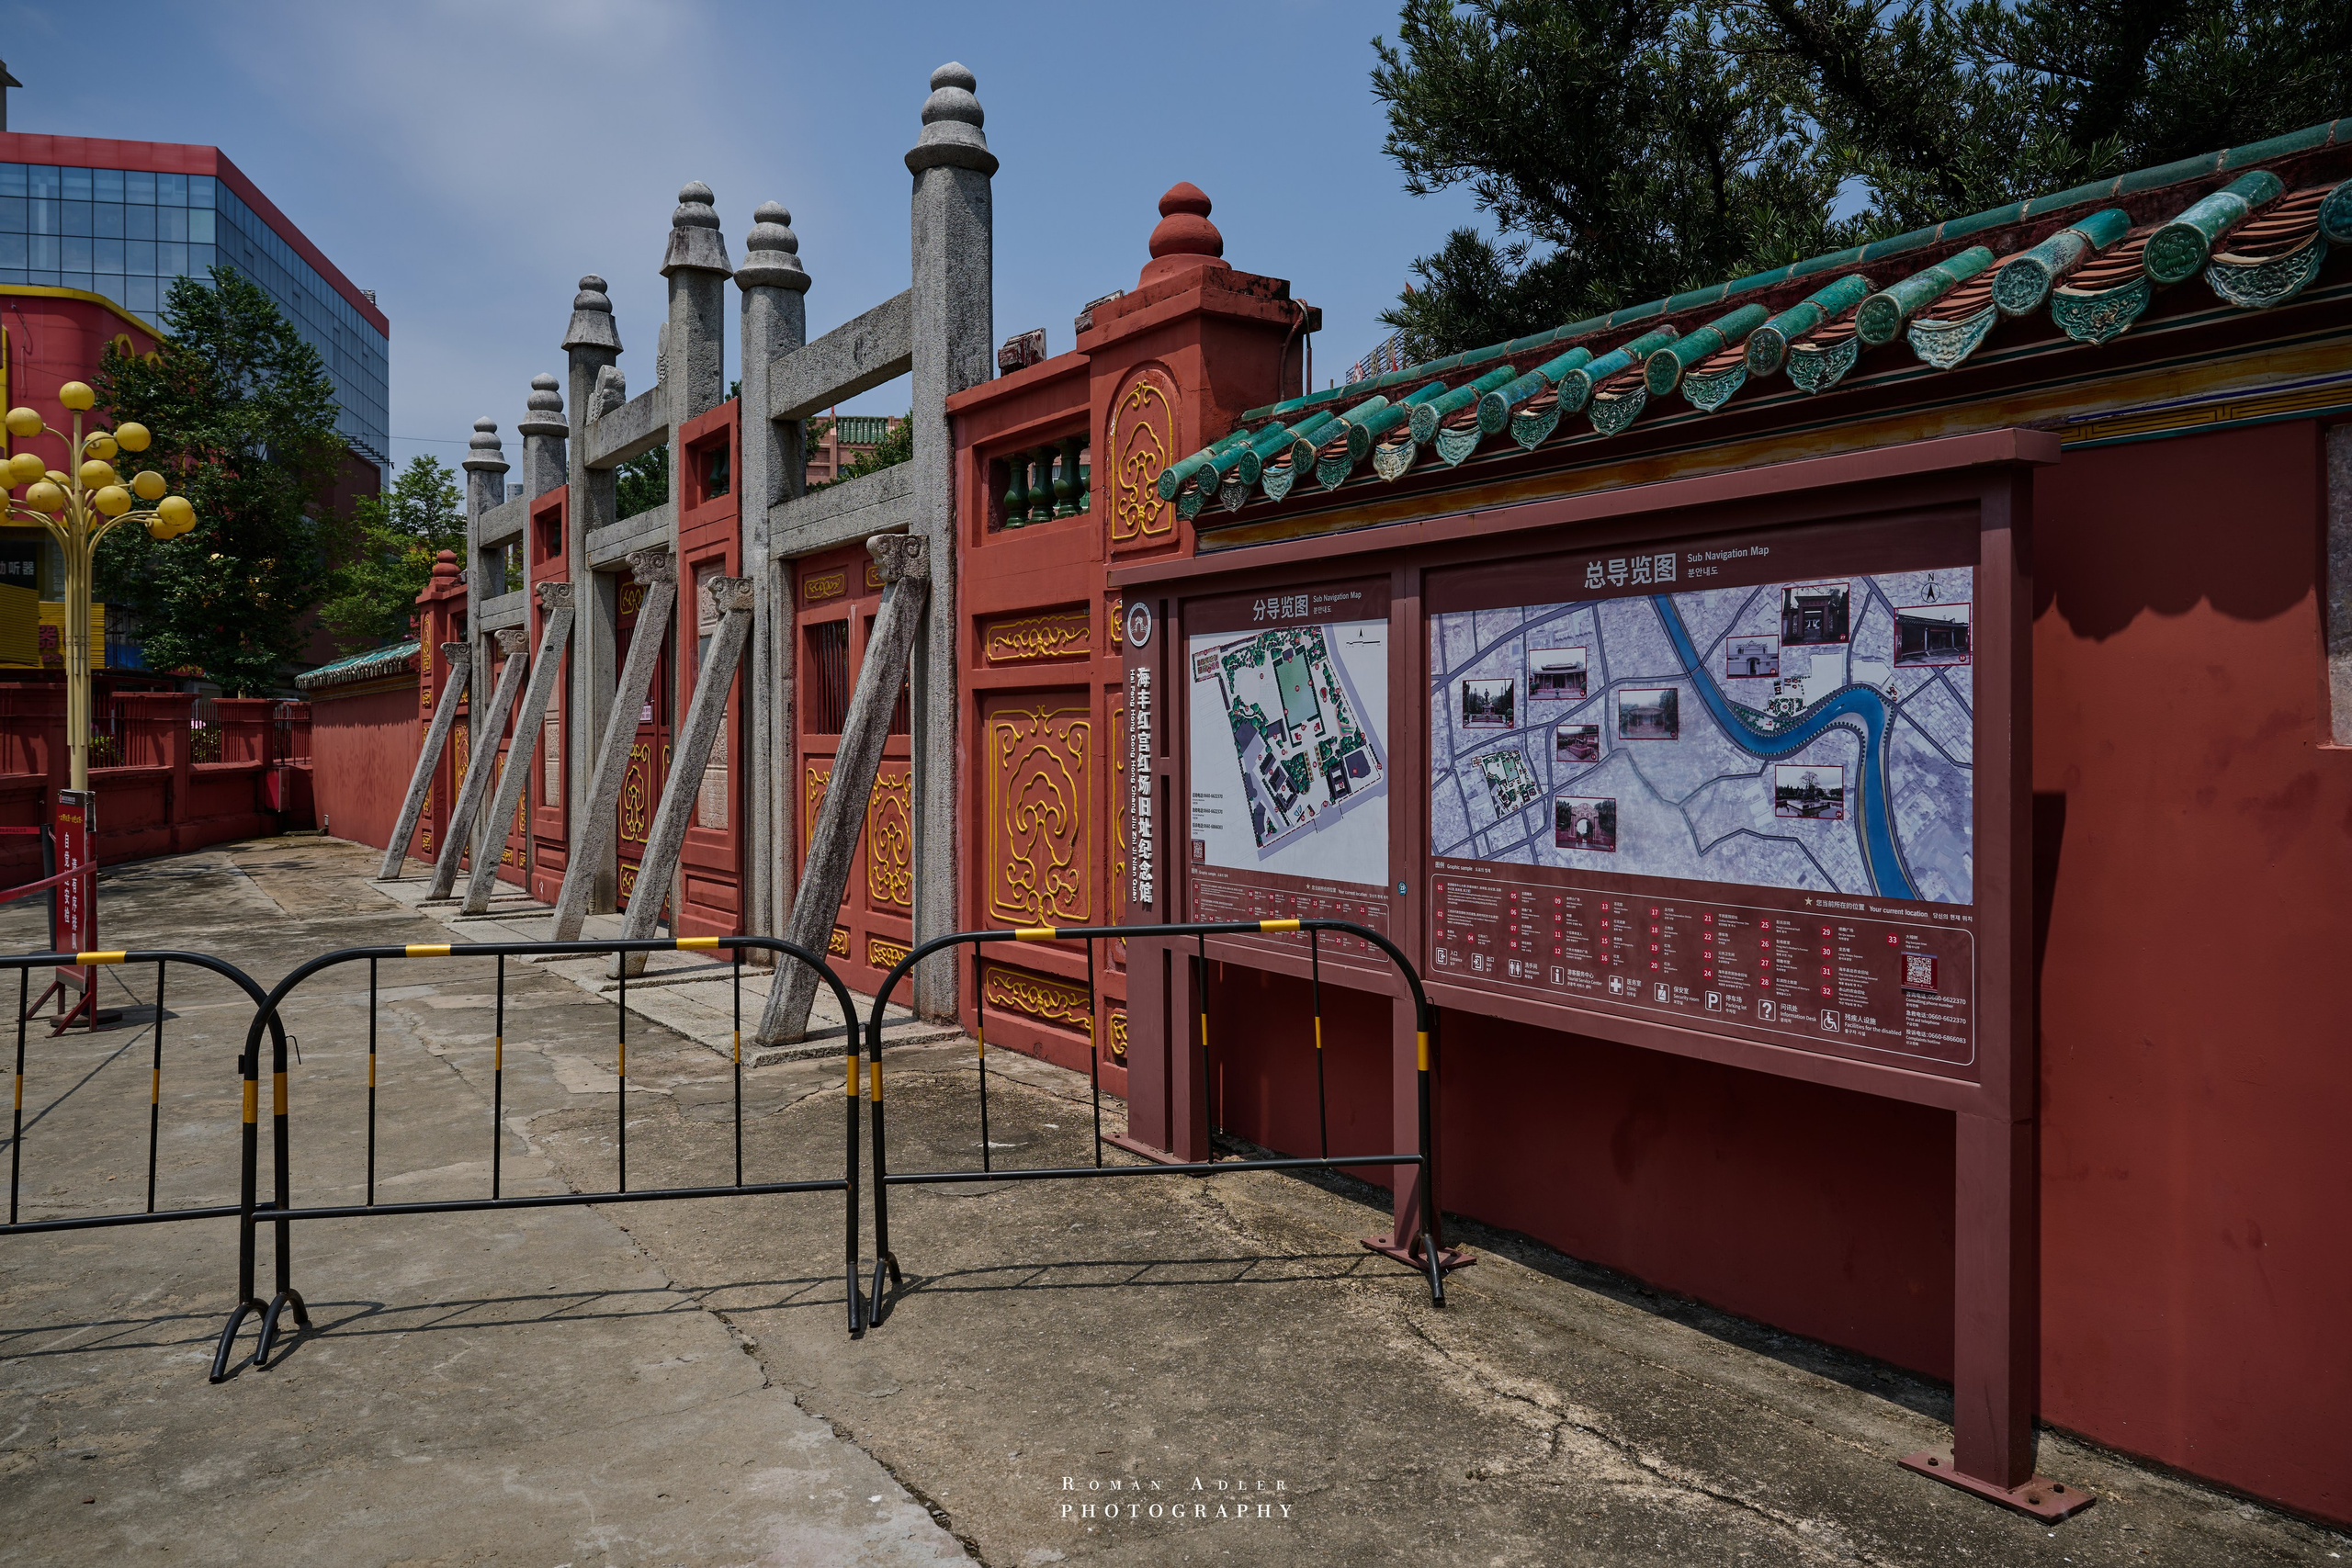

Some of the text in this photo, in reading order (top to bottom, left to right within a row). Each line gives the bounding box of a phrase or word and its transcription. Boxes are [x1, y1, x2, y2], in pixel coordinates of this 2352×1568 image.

[1687, 546, 1770, 563] Sub Navigation Map
[1584, 553, 1677, 589] 总导览图
[1687, 566, 1718, 578] 분안내도
[1324, 592, 1349, 602] Navigation
[1351, 591, 1362, 599] Map
[1253, 594, 1308, 621] 分导览图
[1136, 667, 1152, 903] 海丰红宫红场旧址纪念馆
[1816, 899, 1865, 910] 您当前所在的位置
[1883, 907, 1904, 915] current
[1905, 908, 1928, 917] location
[1566, 968, 1594, 978] 游客服务中心
[1626, 978, 1642, 987] 医务室
[1673, 986, 1689, 995] 保安室
[1725, 994, 1742, 1003] 停车场
[1905, 998, 1927, 1006] Consulting
[1725, 1002, 1740, 1010] Parking
[1780, 1003, 1798, 1013] 问讯处
[1780, 1011, 1805, 1021] Information
[1844, 1013, 1876, 1025] 残疾人设施
[1844, 1021, 1865, 1032] Facilities
[1881, 1027, 1902, 1036] disabled
[1905, 1035, 1927, 1043] Complaints
